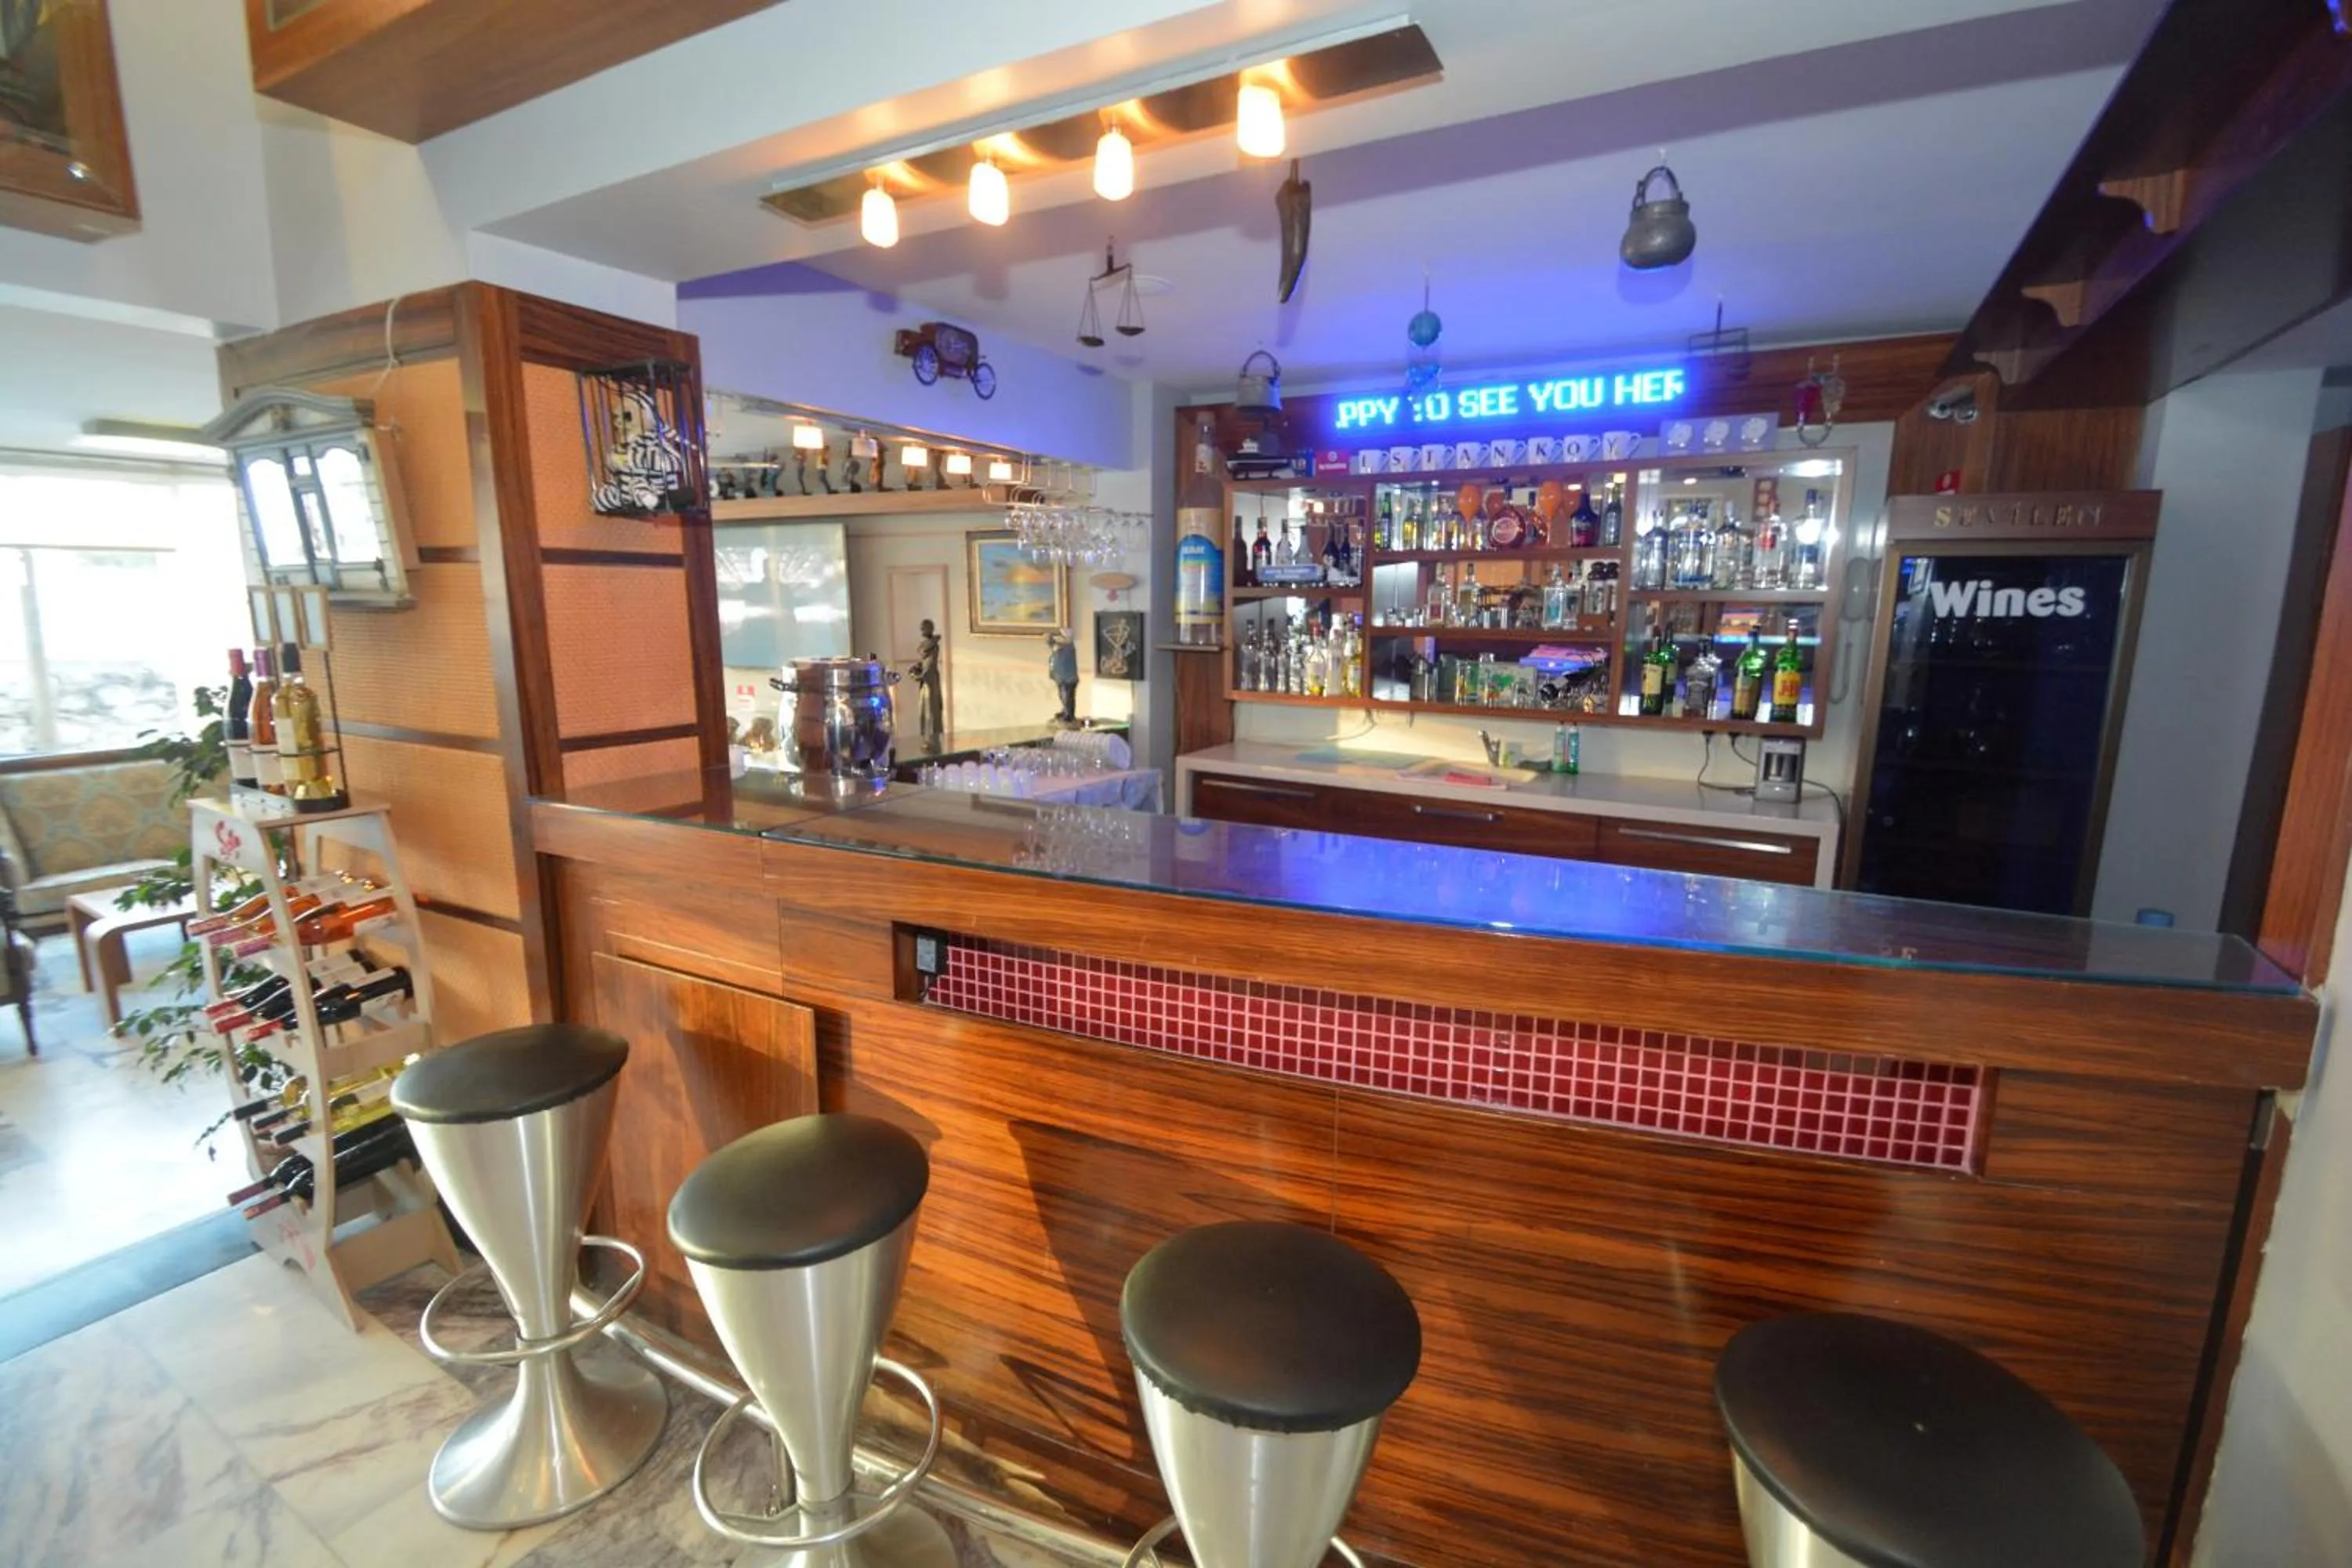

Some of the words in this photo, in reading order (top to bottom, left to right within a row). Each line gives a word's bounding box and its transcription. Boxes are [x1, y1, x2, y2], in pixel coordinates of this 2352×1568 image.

[1336, 397, 1399, 429] PPY
[1458, 385, 1519, 419] SEE
[1528, 376, 1604, 412] YOU
[1929, 579, 2086, 618] Wines
